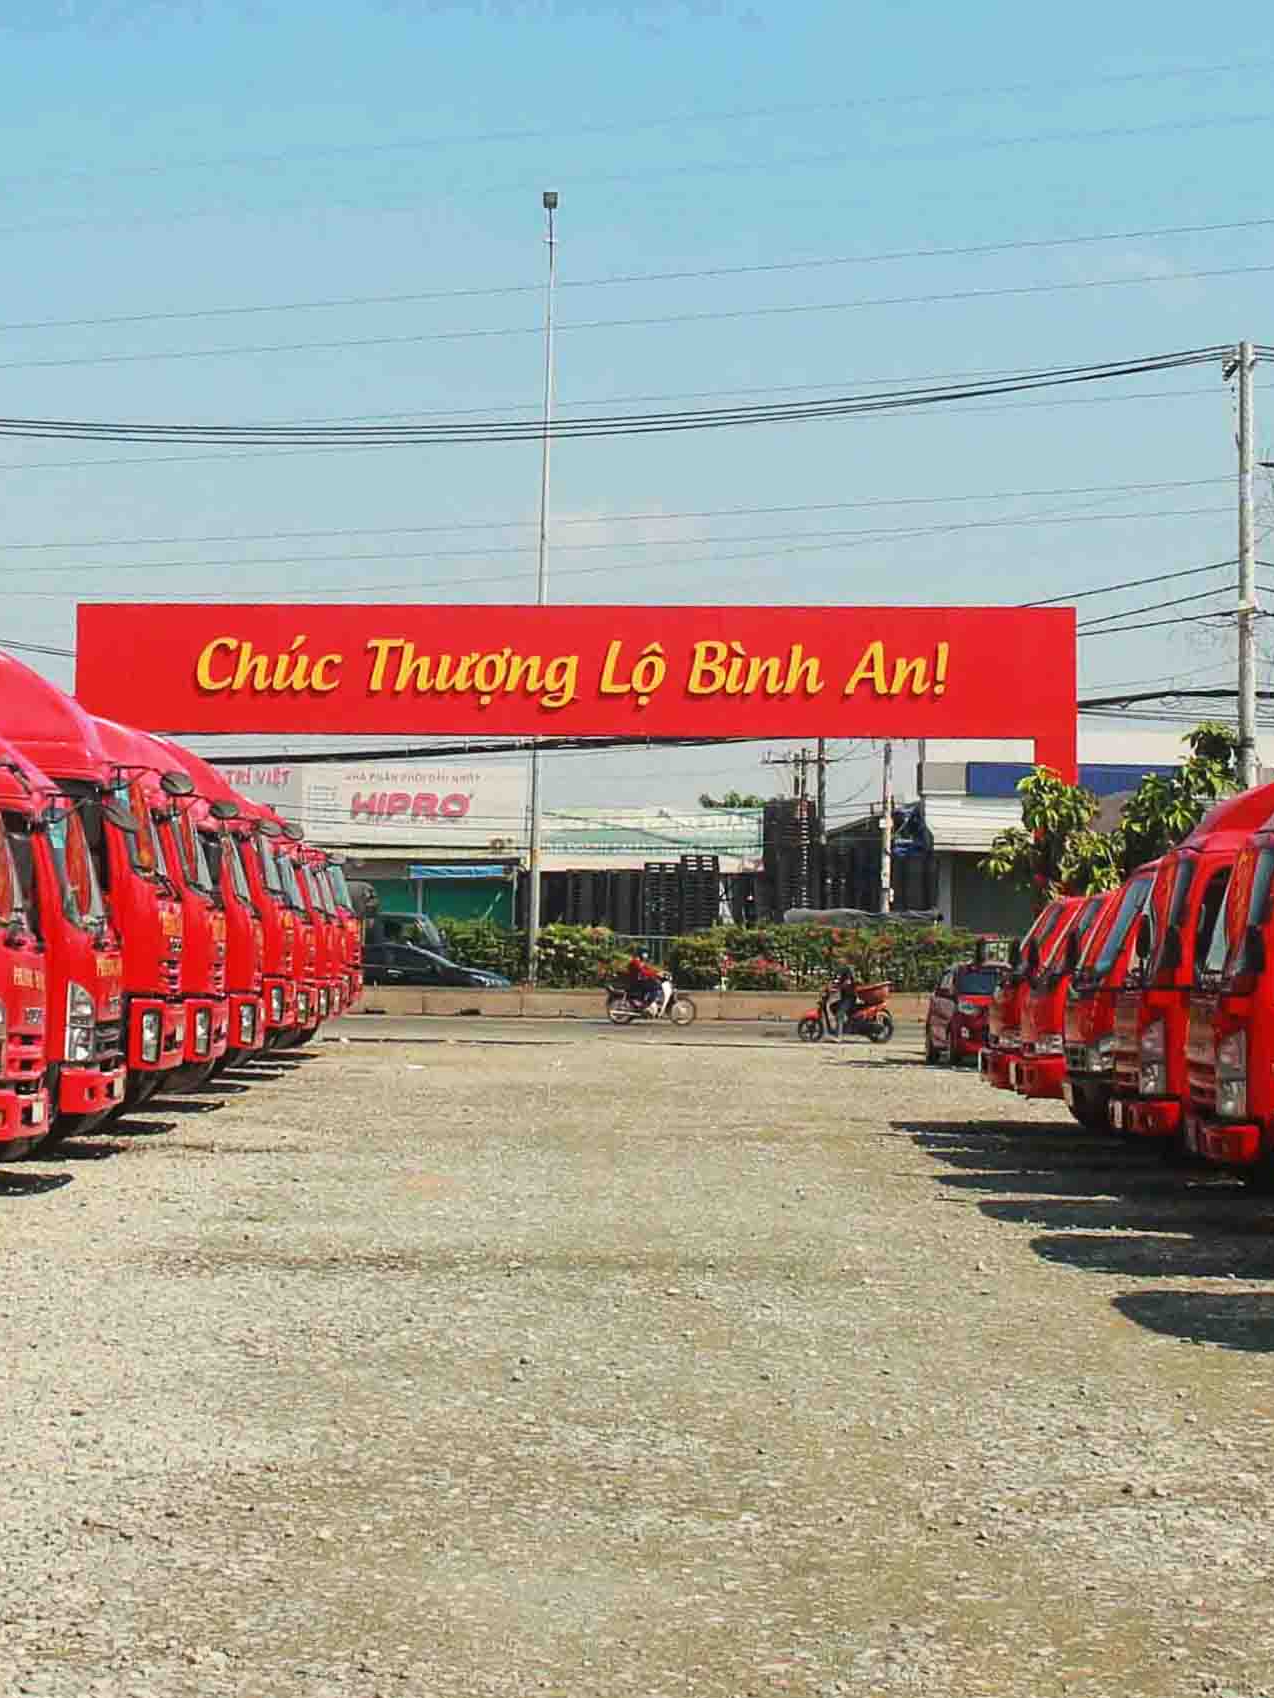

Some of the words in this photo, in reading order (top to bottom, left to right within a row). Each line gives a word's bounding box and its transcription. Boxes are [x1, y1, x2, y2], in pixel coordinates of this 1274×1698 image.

[196, 634, 343, 692] Chúc
[366, 637, 579, 708] Thượng
[599, 639, 667, 706] Lộ
[687, 640, 824, 695] Bình
[843, 640, 950, 696] An!
[350, 791, 472, 820] HIPRO
